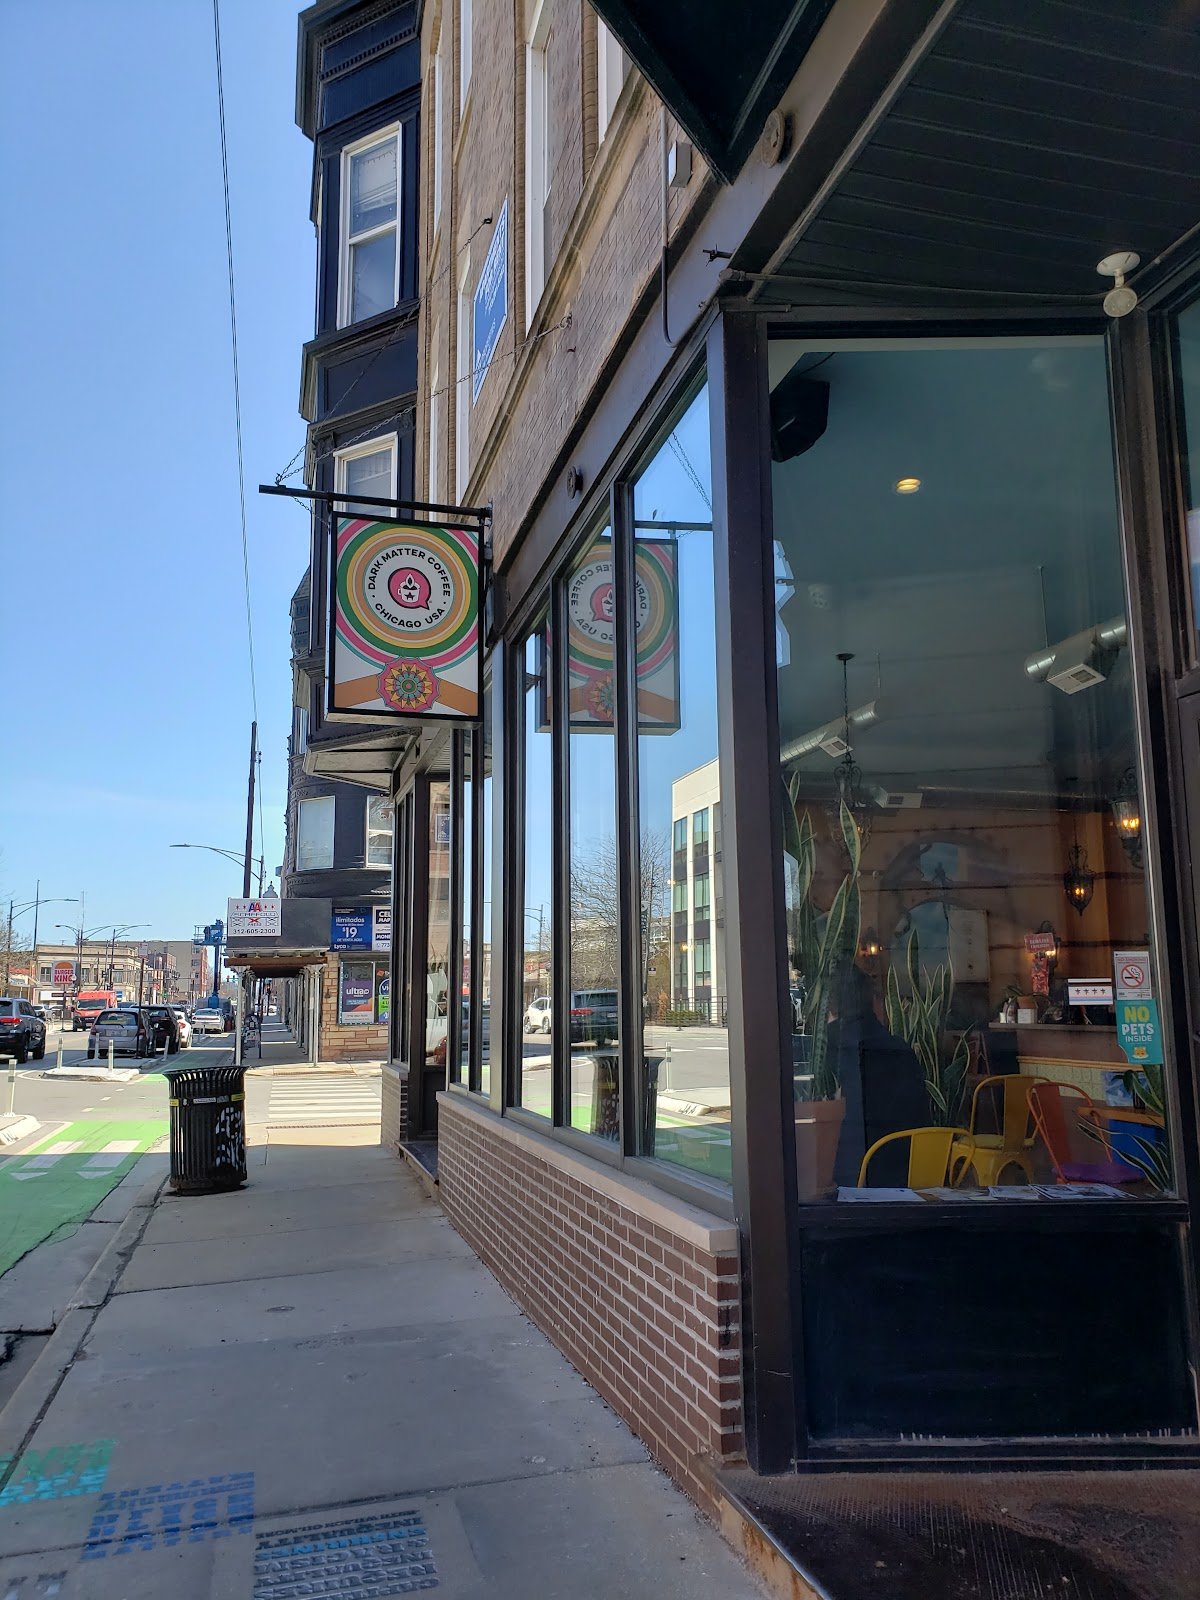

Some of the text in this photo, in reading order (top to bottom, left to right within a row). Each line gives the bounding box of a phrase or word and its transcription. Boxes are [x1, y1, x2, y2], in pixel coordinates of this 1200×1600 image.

[368, 548, 451, 597] DARK MATTER COFFEE
[375, 603, 446, 629] CHICAGO USA
[342, 927, 358, 938] $19
[1124, 1006, 1150, 1022] NO
[1121, 1023, 1155, 1036] PETS
[1124, 1035, 1153, 1043] INSIDE
